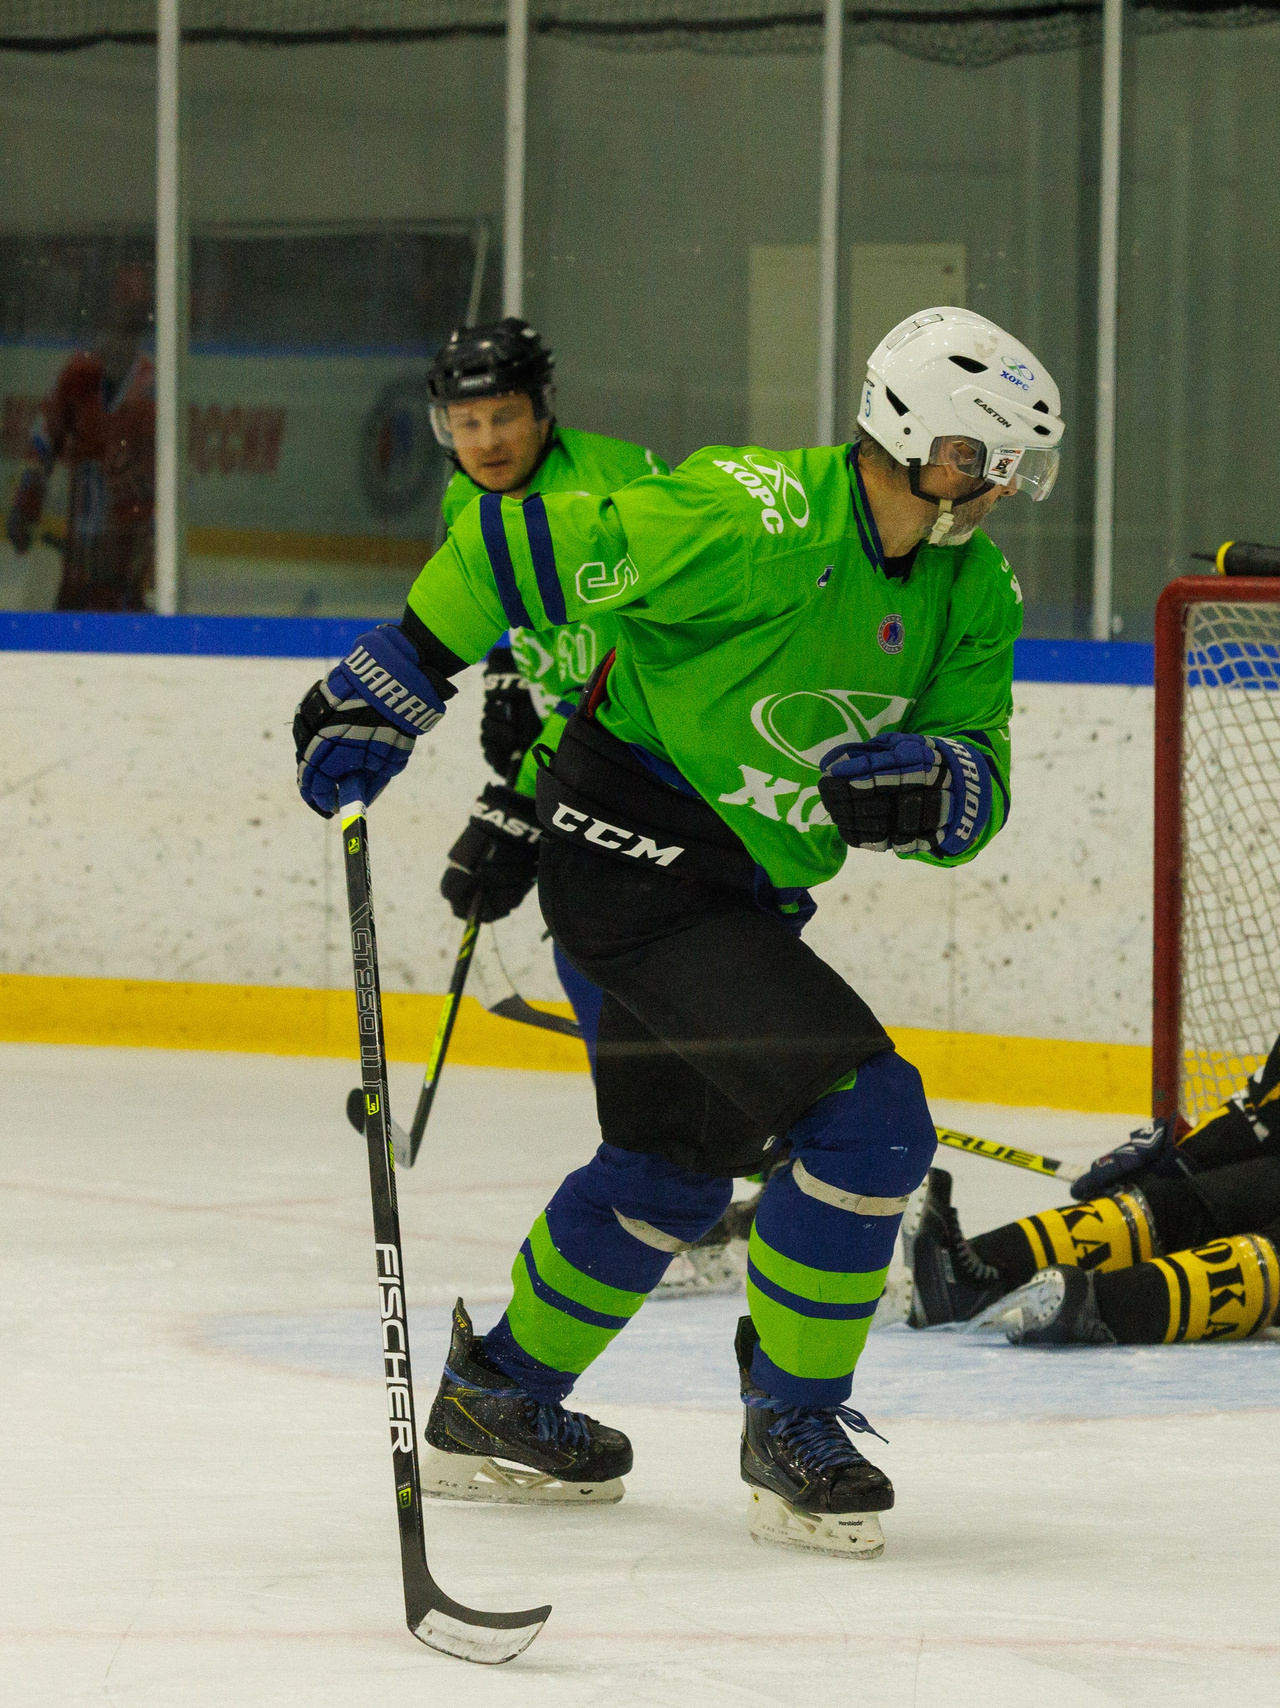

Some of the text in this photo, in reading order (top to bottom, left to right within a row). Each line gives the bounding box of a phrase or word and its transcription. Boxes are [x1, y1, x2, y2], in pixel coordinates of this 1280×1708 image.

[1000, 370, 1029, 391] ХОРС
[865, 390, 871, 417] 5
[974, 398, 1011, 428] EASTON
[344, 645, 445, 732] WARRIO
[473, 802, 544, 844] EAST
[552, 802, 685, 867] CCM
[935, 1126, 1038, 1168] RUE
[1055, 1202, 1112, 1270] КА
[375, 1243, 414, 1454] FISCHER
